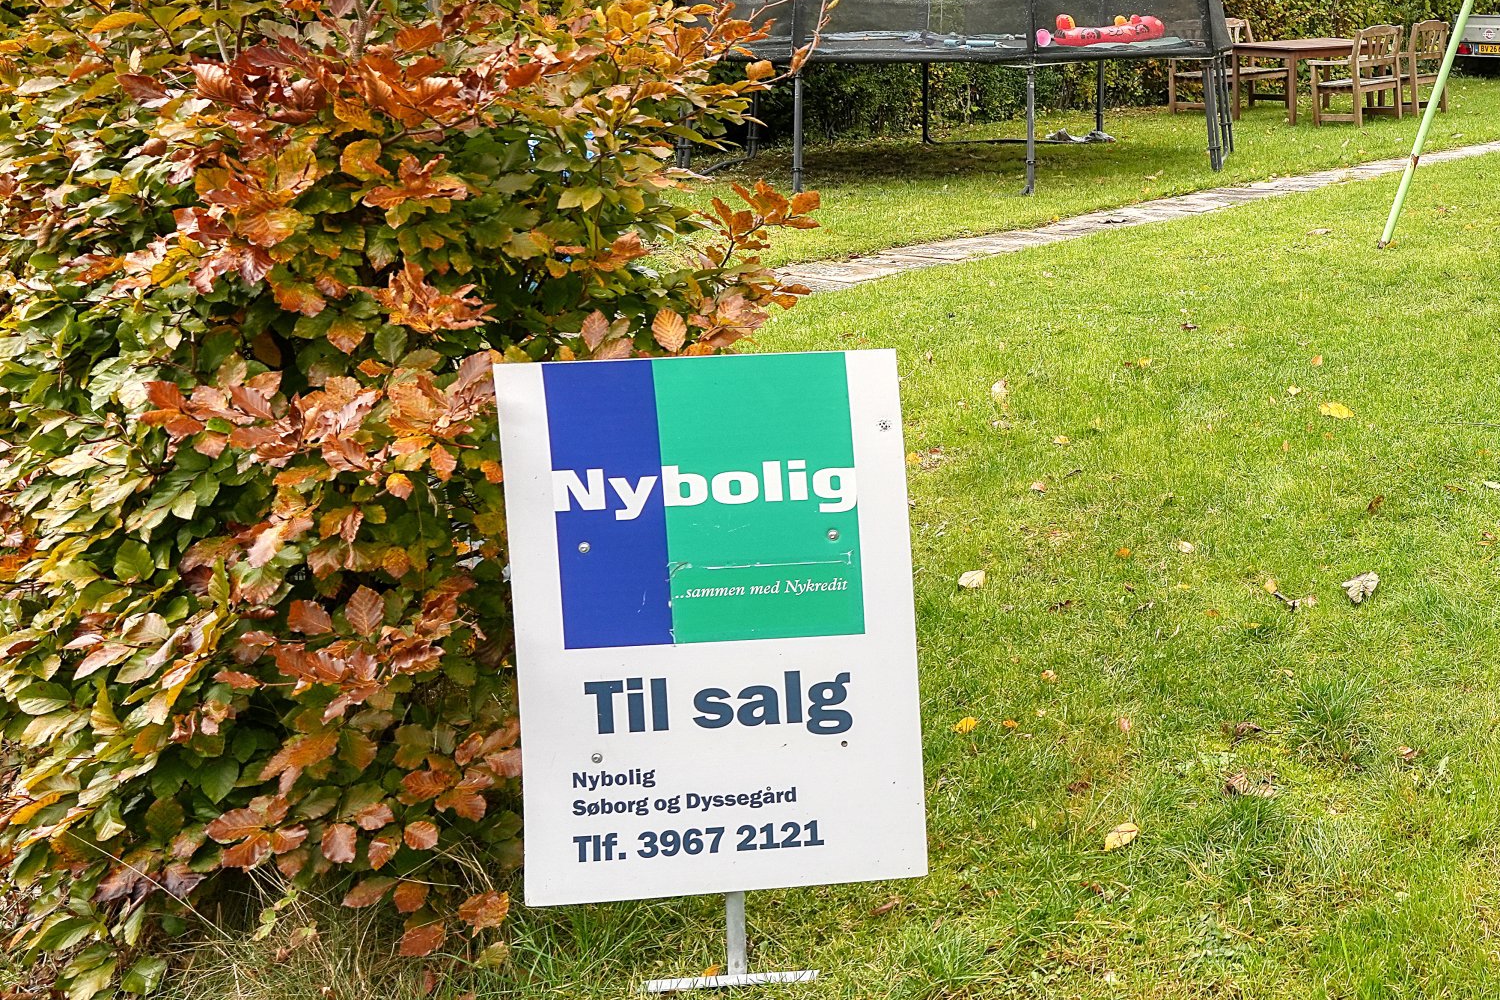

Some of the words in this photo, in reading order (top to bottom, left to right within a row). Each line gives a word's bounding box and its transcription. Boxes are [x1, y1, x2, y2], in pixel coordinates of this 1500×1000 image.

[551, 459, 857, 521] Nybolig
[749, 580, 781, 595] med
[783, 577, 849, 597] Nykredit
[583, 677, 670, 735] Til
[692, 670, 854, 736] salg
[572, 769, 656, 792] Nybolig
[572, 796, 650, 817] Søborg
[653, 797, 681, 814] og
[685, 785, 798, 812] Dyssegård
[572, 832, 627, 863] Tlf.
[636, 826, 725, 859] 3967
[736, 819, 825, 852] 2121
